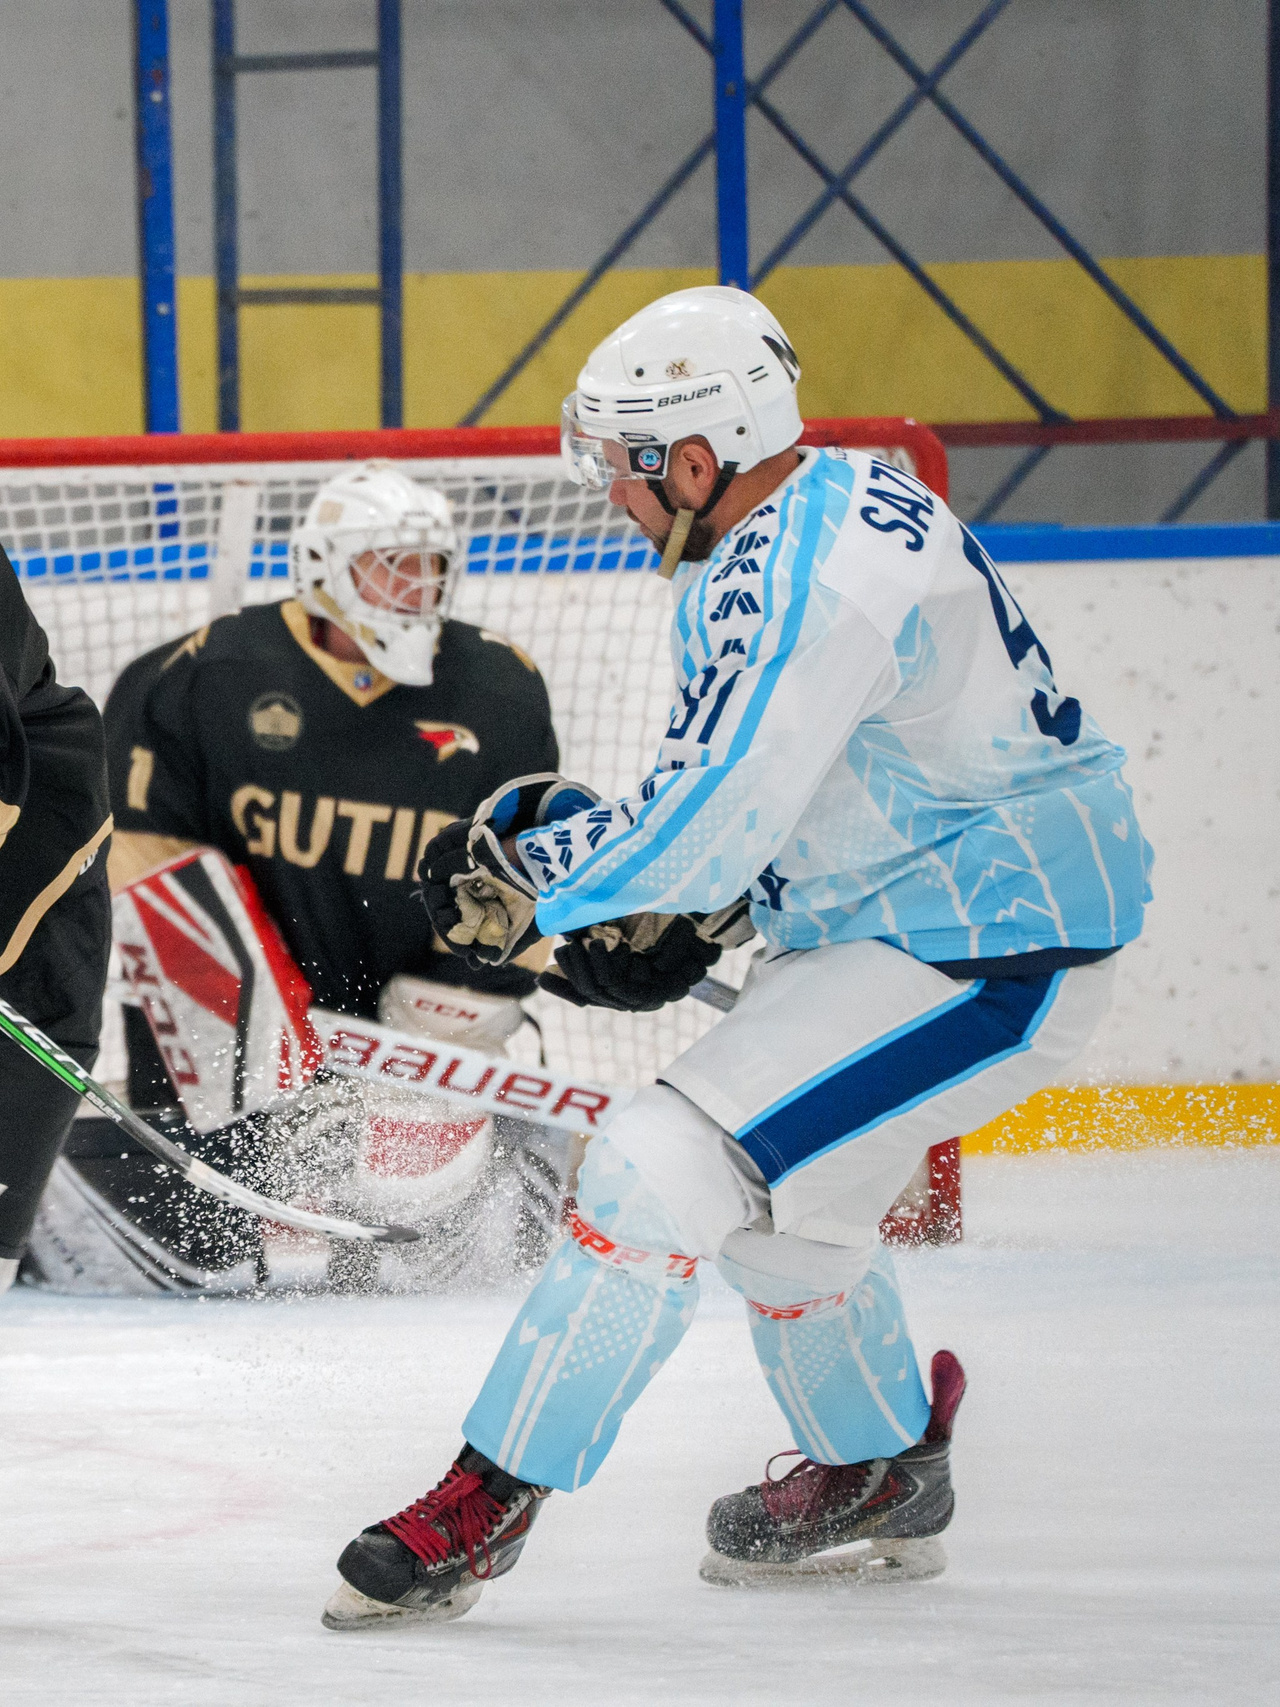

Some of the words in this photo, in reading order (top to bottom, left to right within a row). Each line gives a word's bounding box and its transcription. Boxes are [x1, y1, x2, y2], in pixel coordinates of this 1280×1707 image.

[657, 384, 723, 408] BAUER
[119, 942, 200, 1085] CCM
[414, 998, 479, 1022] CCM
[328, 1030, 611, 1126] BAUER
